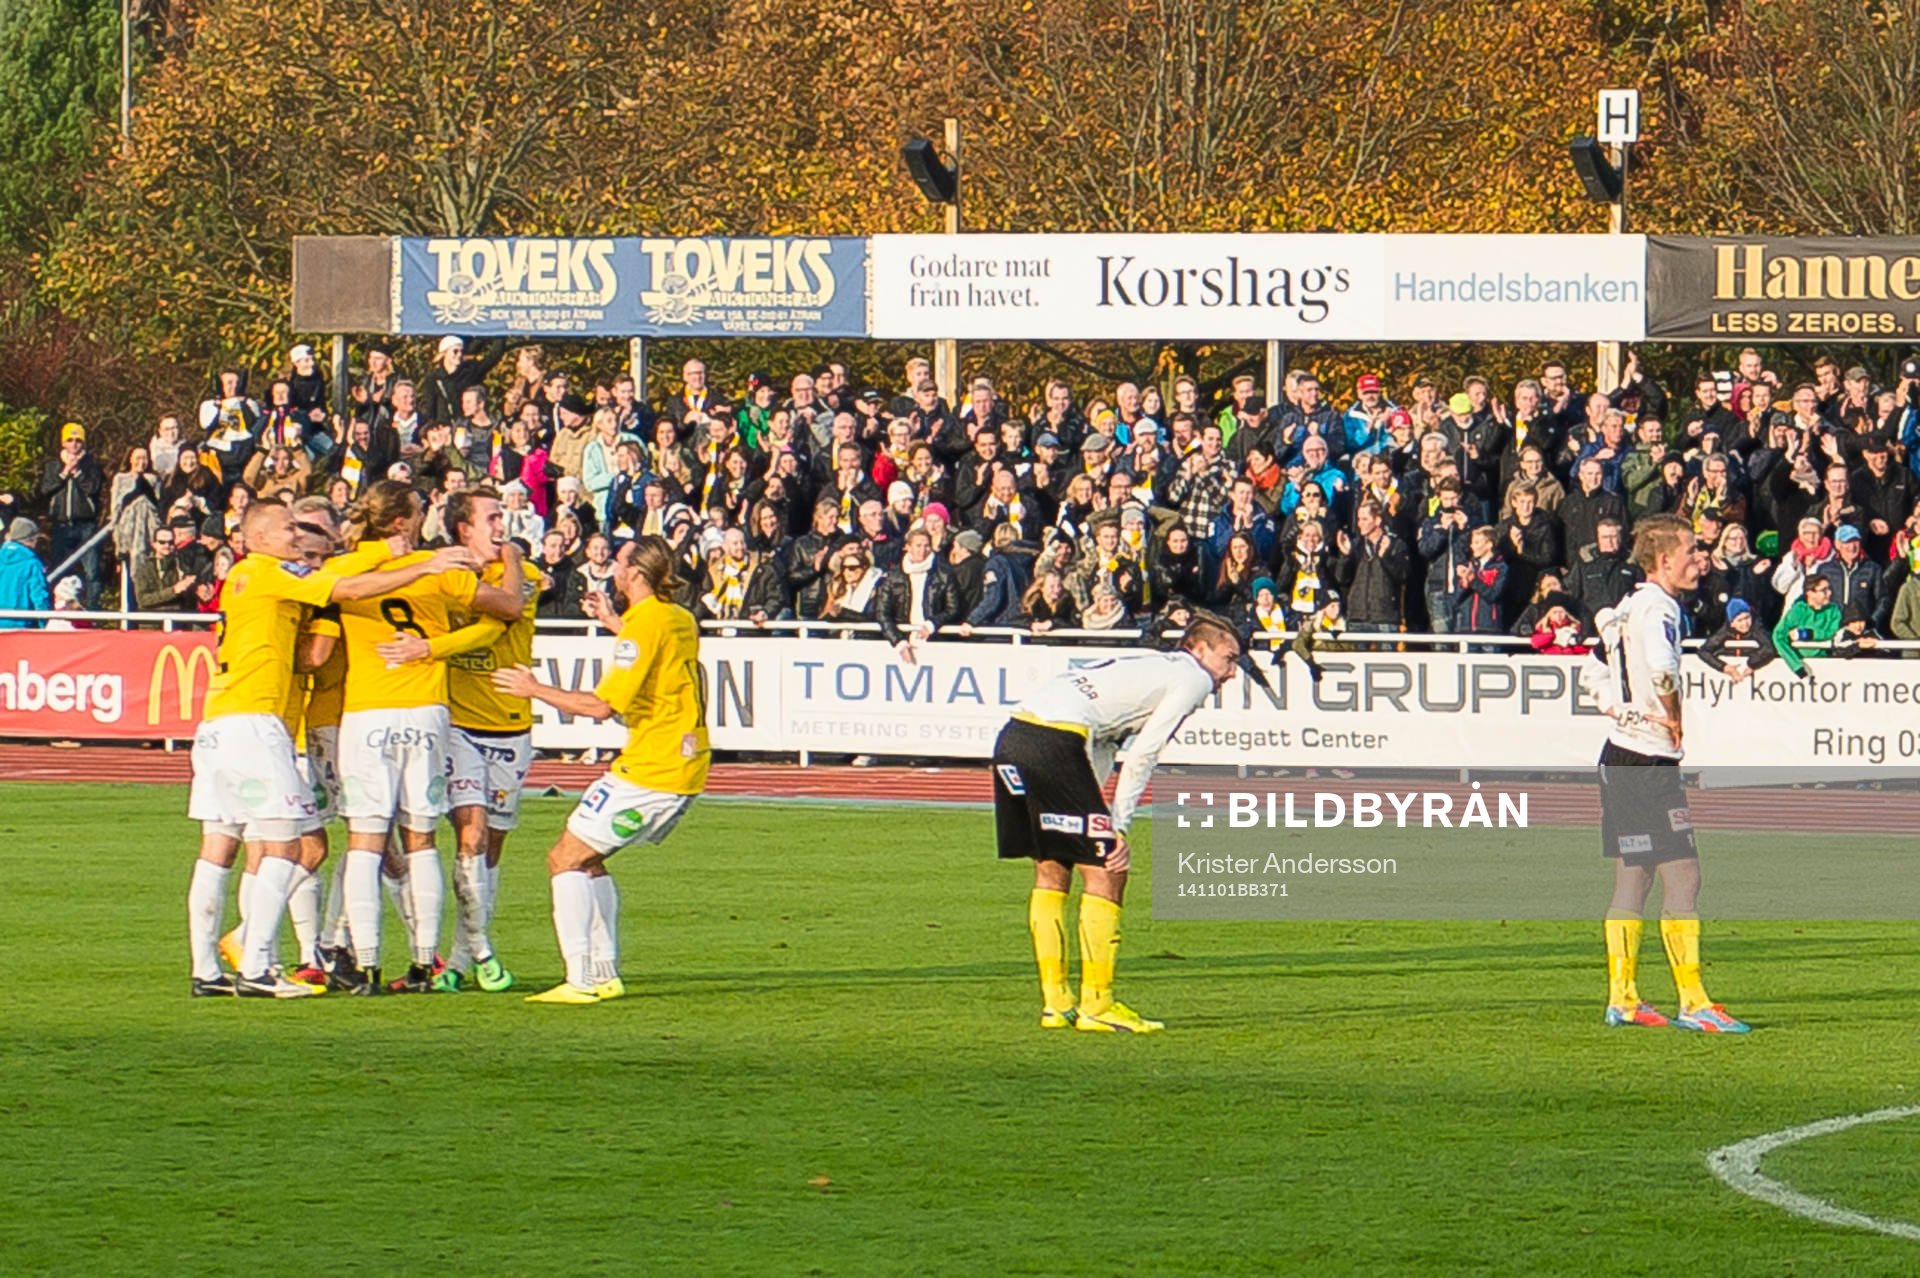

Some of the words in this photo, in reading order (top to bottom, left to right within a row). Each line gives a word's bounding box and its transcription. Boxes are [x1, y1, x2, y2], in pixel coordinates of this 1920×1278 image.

[1604, 97, 1630, 134] H
[427, 239, 618, 306] TOVEKS
[641, 239, 836, 307] TOVEKS
[909, 254, 999, 278] Godare
[1005, 257, 1051, 278] mat
[909, 282, 960, 307] från
[967, 282, 1040, 308] havet.
[1394, 272, 1639, 302] Handelsbanken
[1711, 312, 1779, 333] LESS
[1787, 312, 1904, 333] ZEROES.
[793, 660, 1024, 706] TOMAL
[1685, 671, 1736, 707] Hyr
[1750, 672, 1853, 704] kontor
[791, 720, 909, 738] METERING
[919, 723, 998, 741] SYSTE
[1302, 728, 1389, 749] Center
[1813, 728, 1886, 764] Ring
[1898, 729, 1920, 758] 0
[1095, 841, 1106, 858] 3
